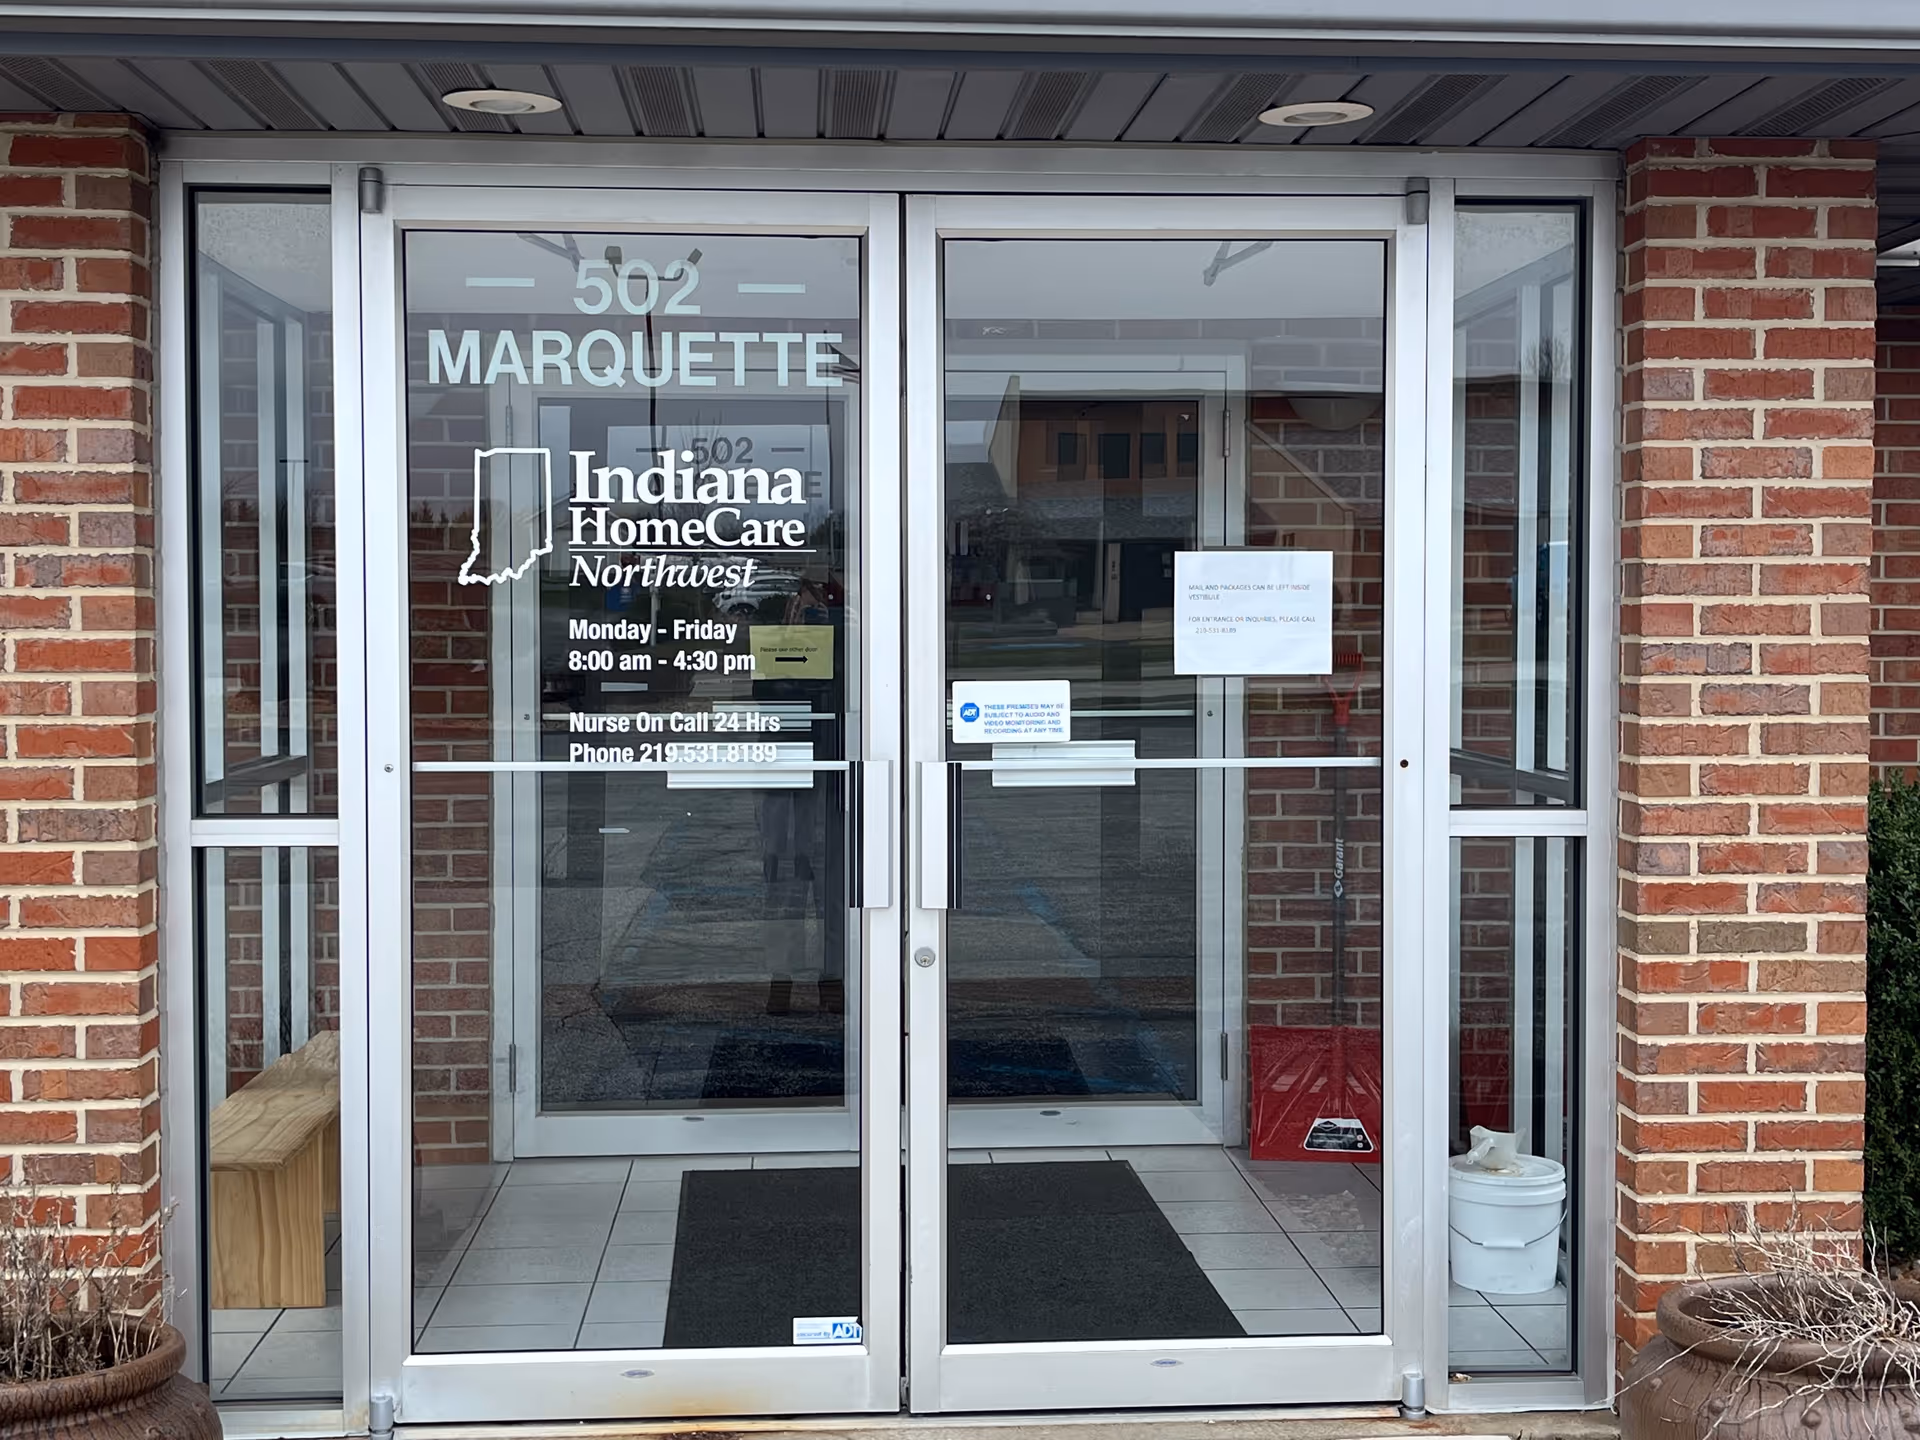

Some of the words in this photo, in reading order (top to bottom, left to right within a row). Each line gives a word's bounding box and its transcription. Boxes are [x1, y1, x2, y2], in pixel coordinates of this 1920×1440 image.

[573, 259, 702, 315] 502
[428, 329, 844, 388] MARQUETTE
[569, 449, 807, 505] Indiana
[568, 506, 805, 547] HomeCare
[569, 555, 758, 588] Northwest
[568, 619, 651, 644] Monday
[673, 619, 738, 644] Friday
[568, 650, 613, 671] 8:00
[619, 654, 651, 671] am
[673, 650, 717, 671] 4:30
[723, 654, 756, 675] pm
[569, 712, 631, 733] Nurse
[636, 712, 664, 733] On
[670, 712, 709, 733] Call
[713, 712, 740, 733] 24
[745, 712, 781, 733] Hrs
[569, 743, 635, 763] Phone
[640, 743, 777, 763] 219.531.8189
[832, 1323, 859, 1339] ADT
